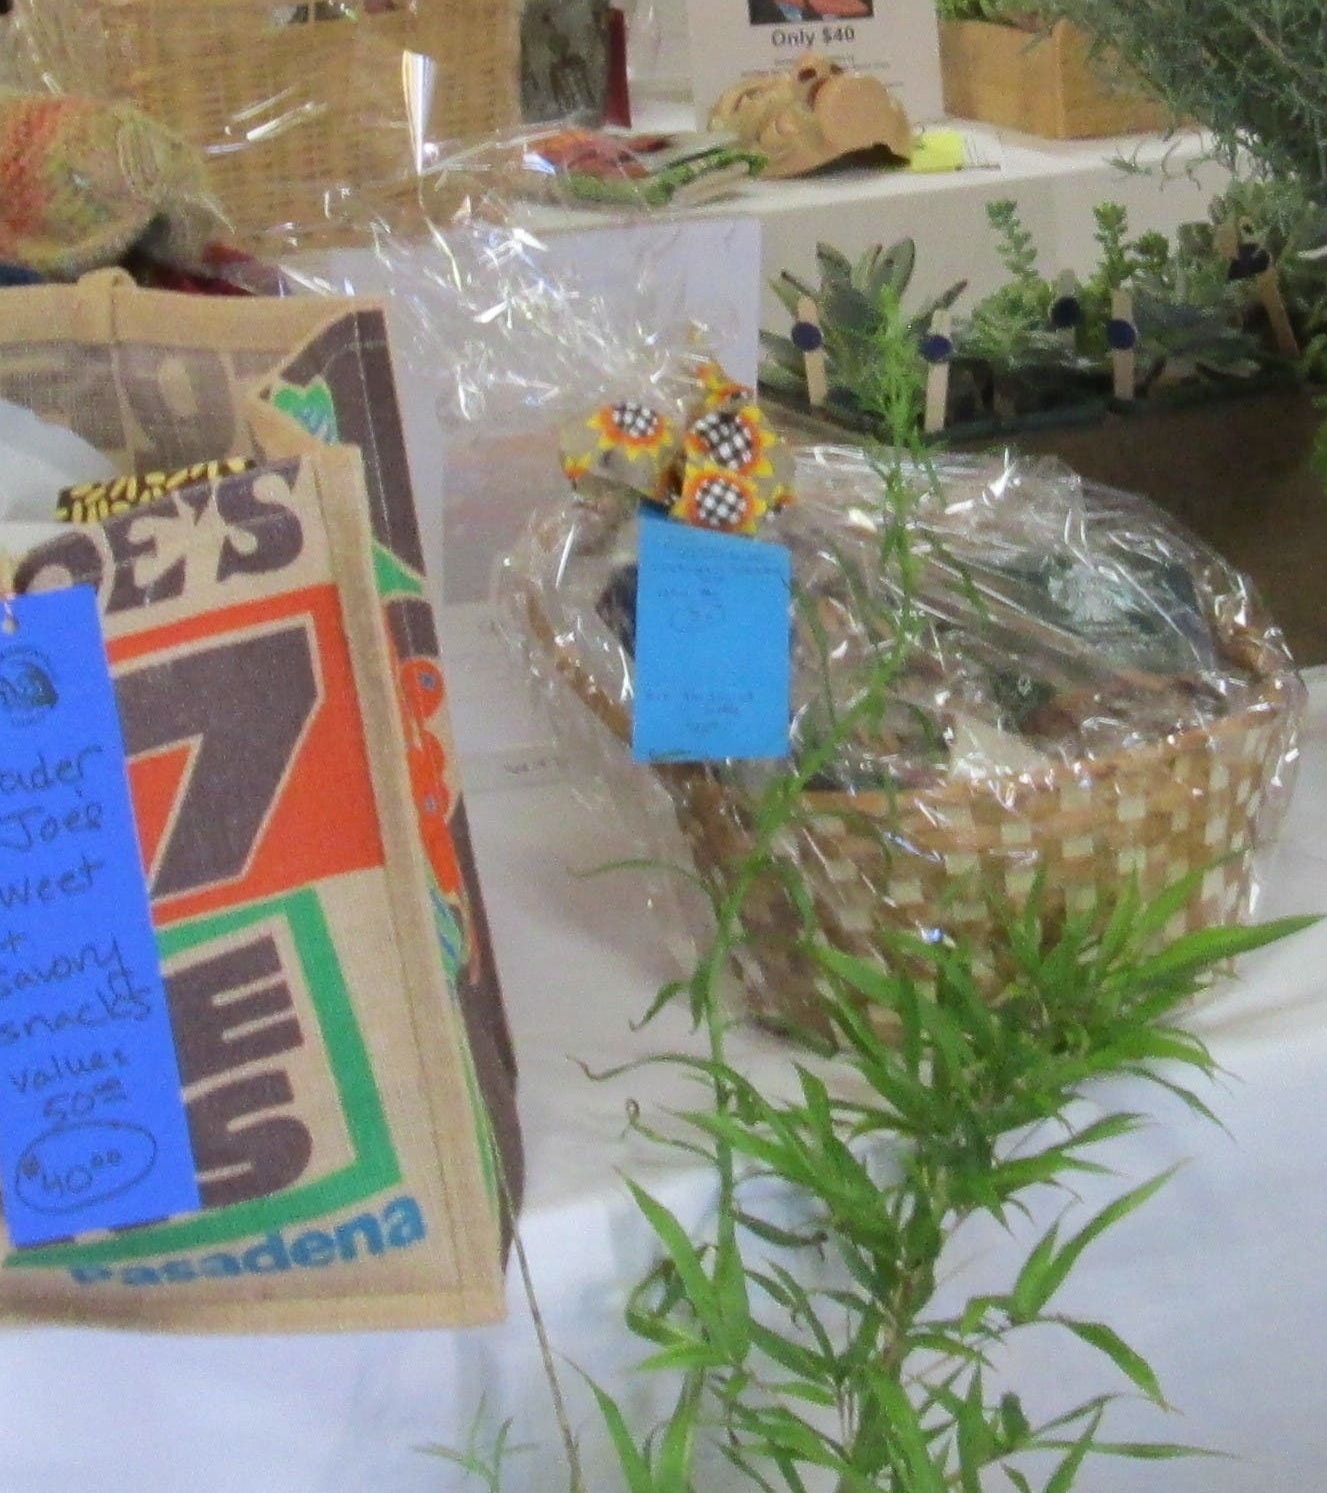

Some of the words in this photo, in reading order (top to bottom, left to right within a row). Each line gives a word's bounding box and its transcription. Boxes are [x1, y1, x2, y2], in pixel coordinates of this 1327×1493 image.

[772, 28, 816, 48] Only
[822, 26, 856, 44] $40
[70, 1194, 425, 1286] Pasadena
